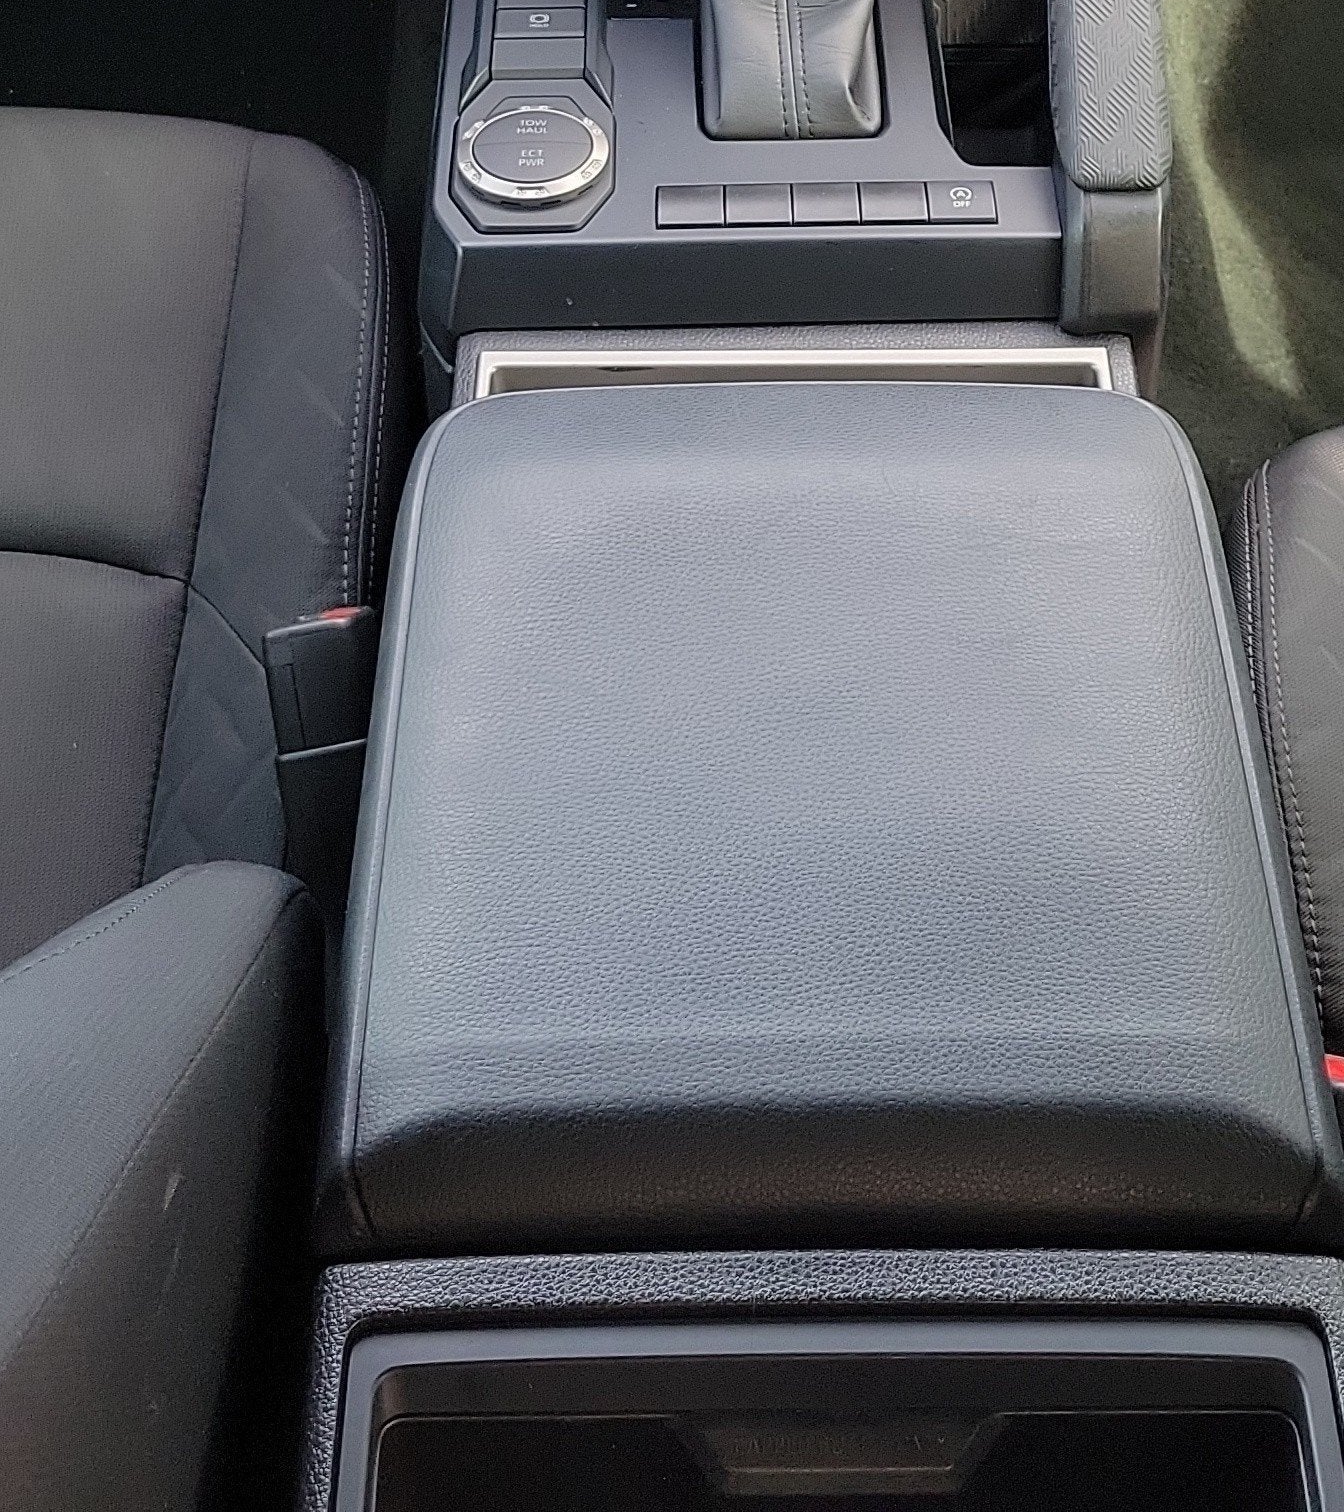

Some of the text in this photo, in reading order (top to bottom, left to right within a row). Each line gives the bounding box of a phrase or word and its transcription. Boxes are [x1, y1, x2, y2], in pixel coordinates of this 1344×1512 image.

[520, 119, 547, 127] TOW
[521, 149, 543, 157] ECT
[518, 158, 545, 166] PWR
[952, 200, 972, 208] OFF
